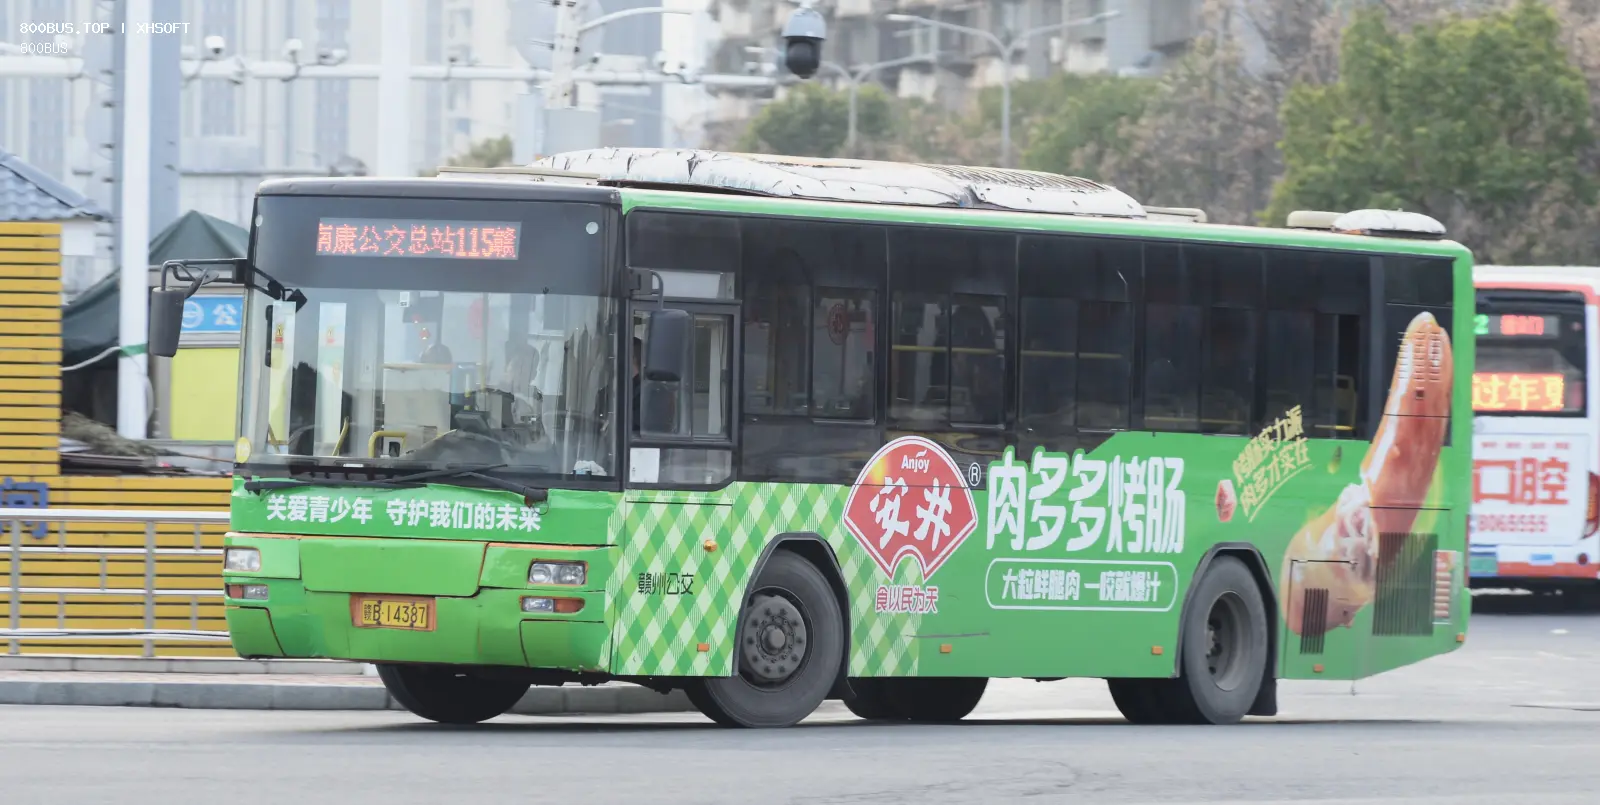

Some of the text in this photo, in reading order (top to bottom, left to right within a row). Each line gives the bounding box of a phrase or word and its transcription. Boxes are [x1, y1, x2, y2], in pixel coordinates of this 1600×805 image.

[901, 449, 930, 473] Anjoy
[1473, 457, 1569, 506] 口腔
[267, 494, 541, 533] 关爱青少年 守护我们的未来
[869, 477, 952, 551] 安井
[986, 449, 1186, 554] 肉多多烤肠
[638, 572, 695, 596] 赣州公交
[875, 585, 939, 613] 食以民为天
[1001, 568, 1162, 602] 大粒鲜腿肉 一咬就爆汁
